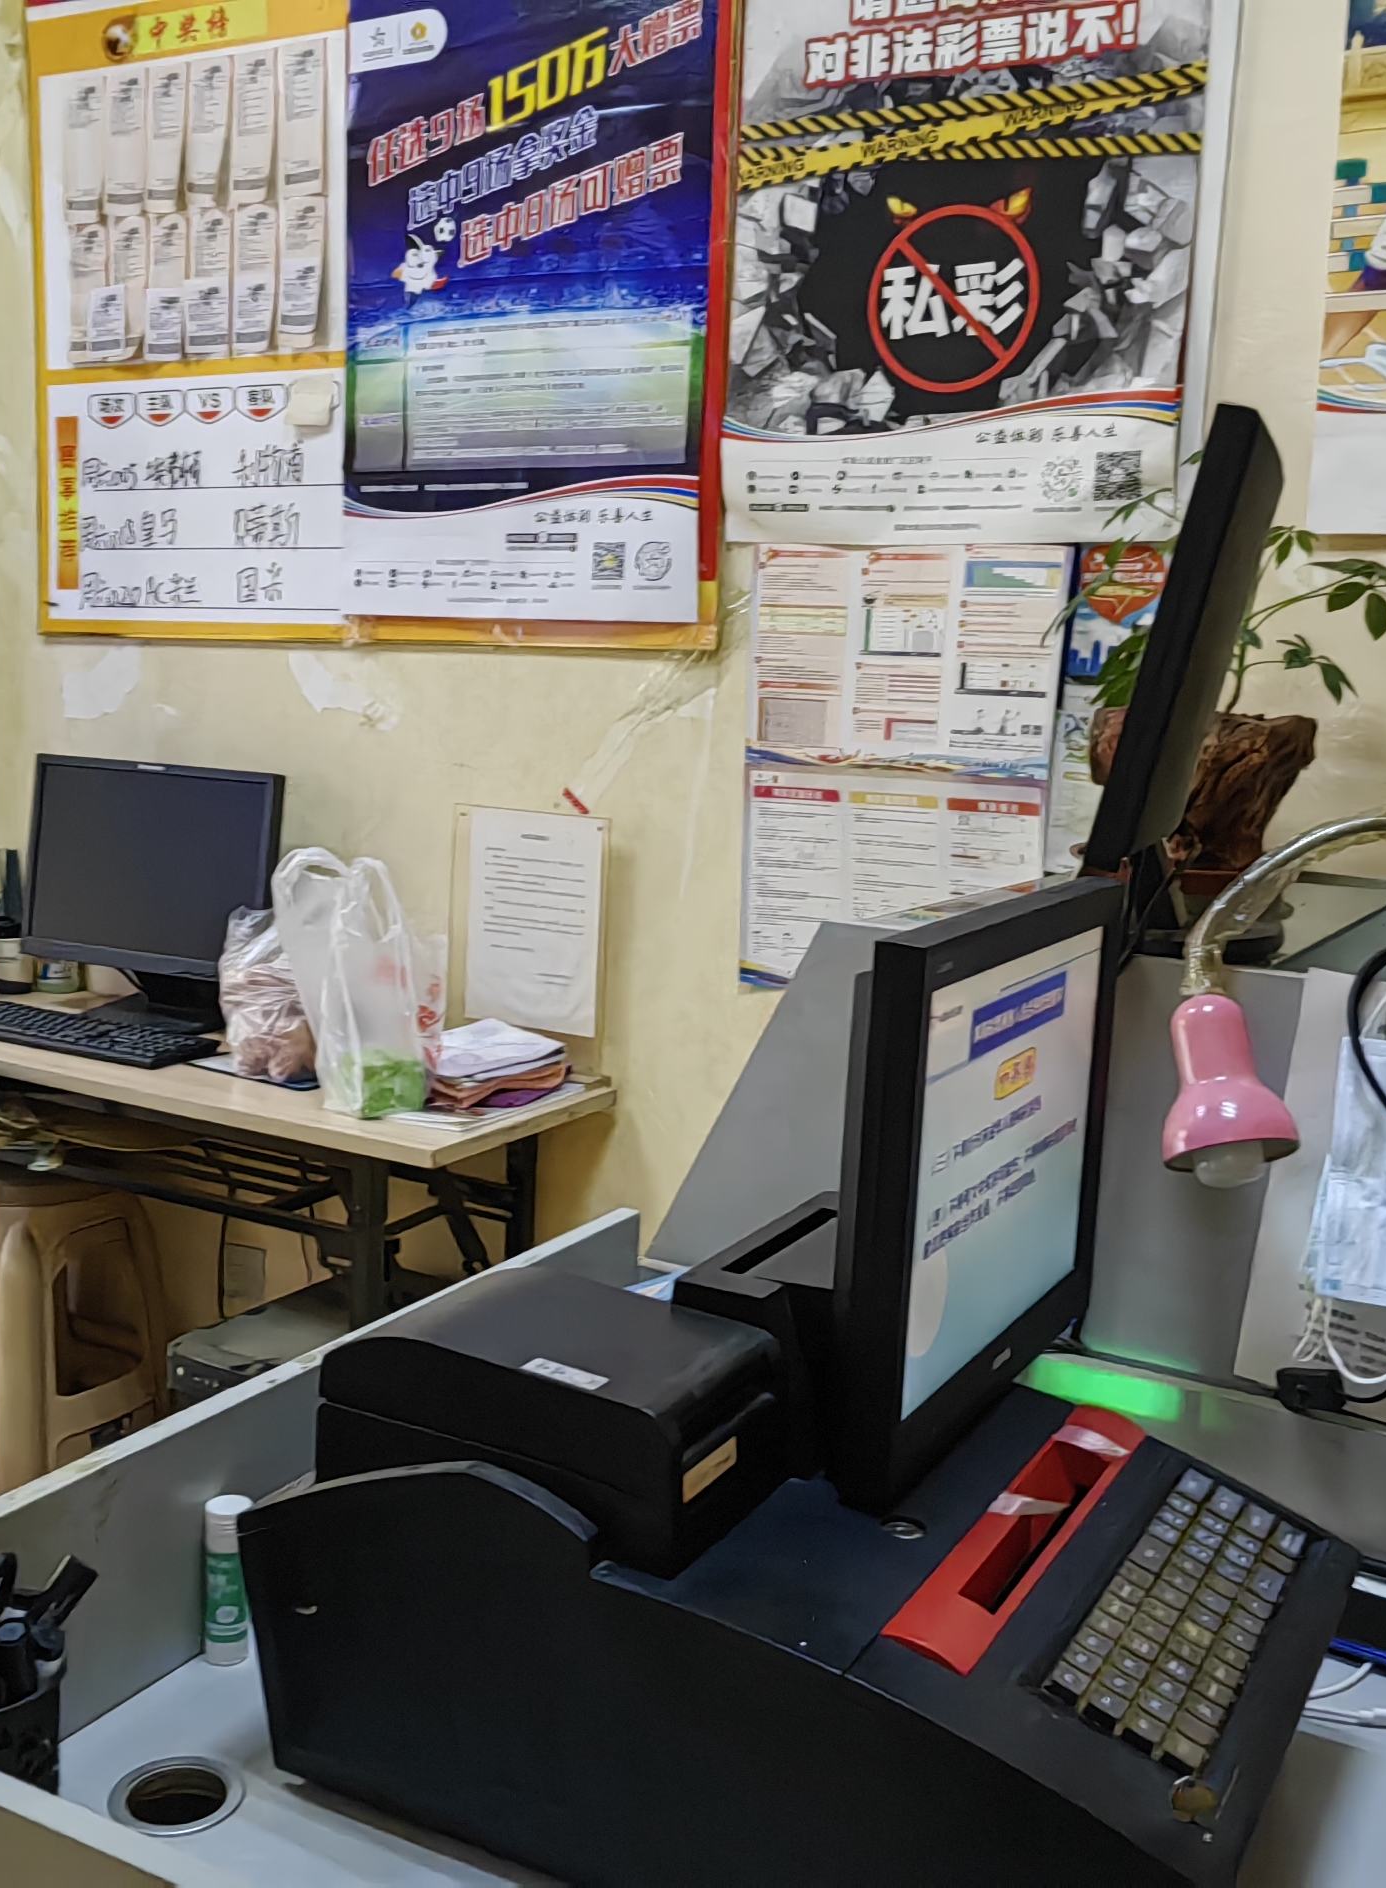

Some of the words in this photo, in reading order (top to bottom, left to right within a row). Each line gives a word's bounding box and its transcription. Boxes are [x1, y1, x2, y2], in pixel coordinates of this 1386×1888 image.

[1003, 100, 1086, 127] WARNING
[861, 130, 939, 157] WARNING
[740, 158, 806, 182] ARNING
[881, 257, 1026, 340] 私彩
[198, 393, 221, 407] VS
